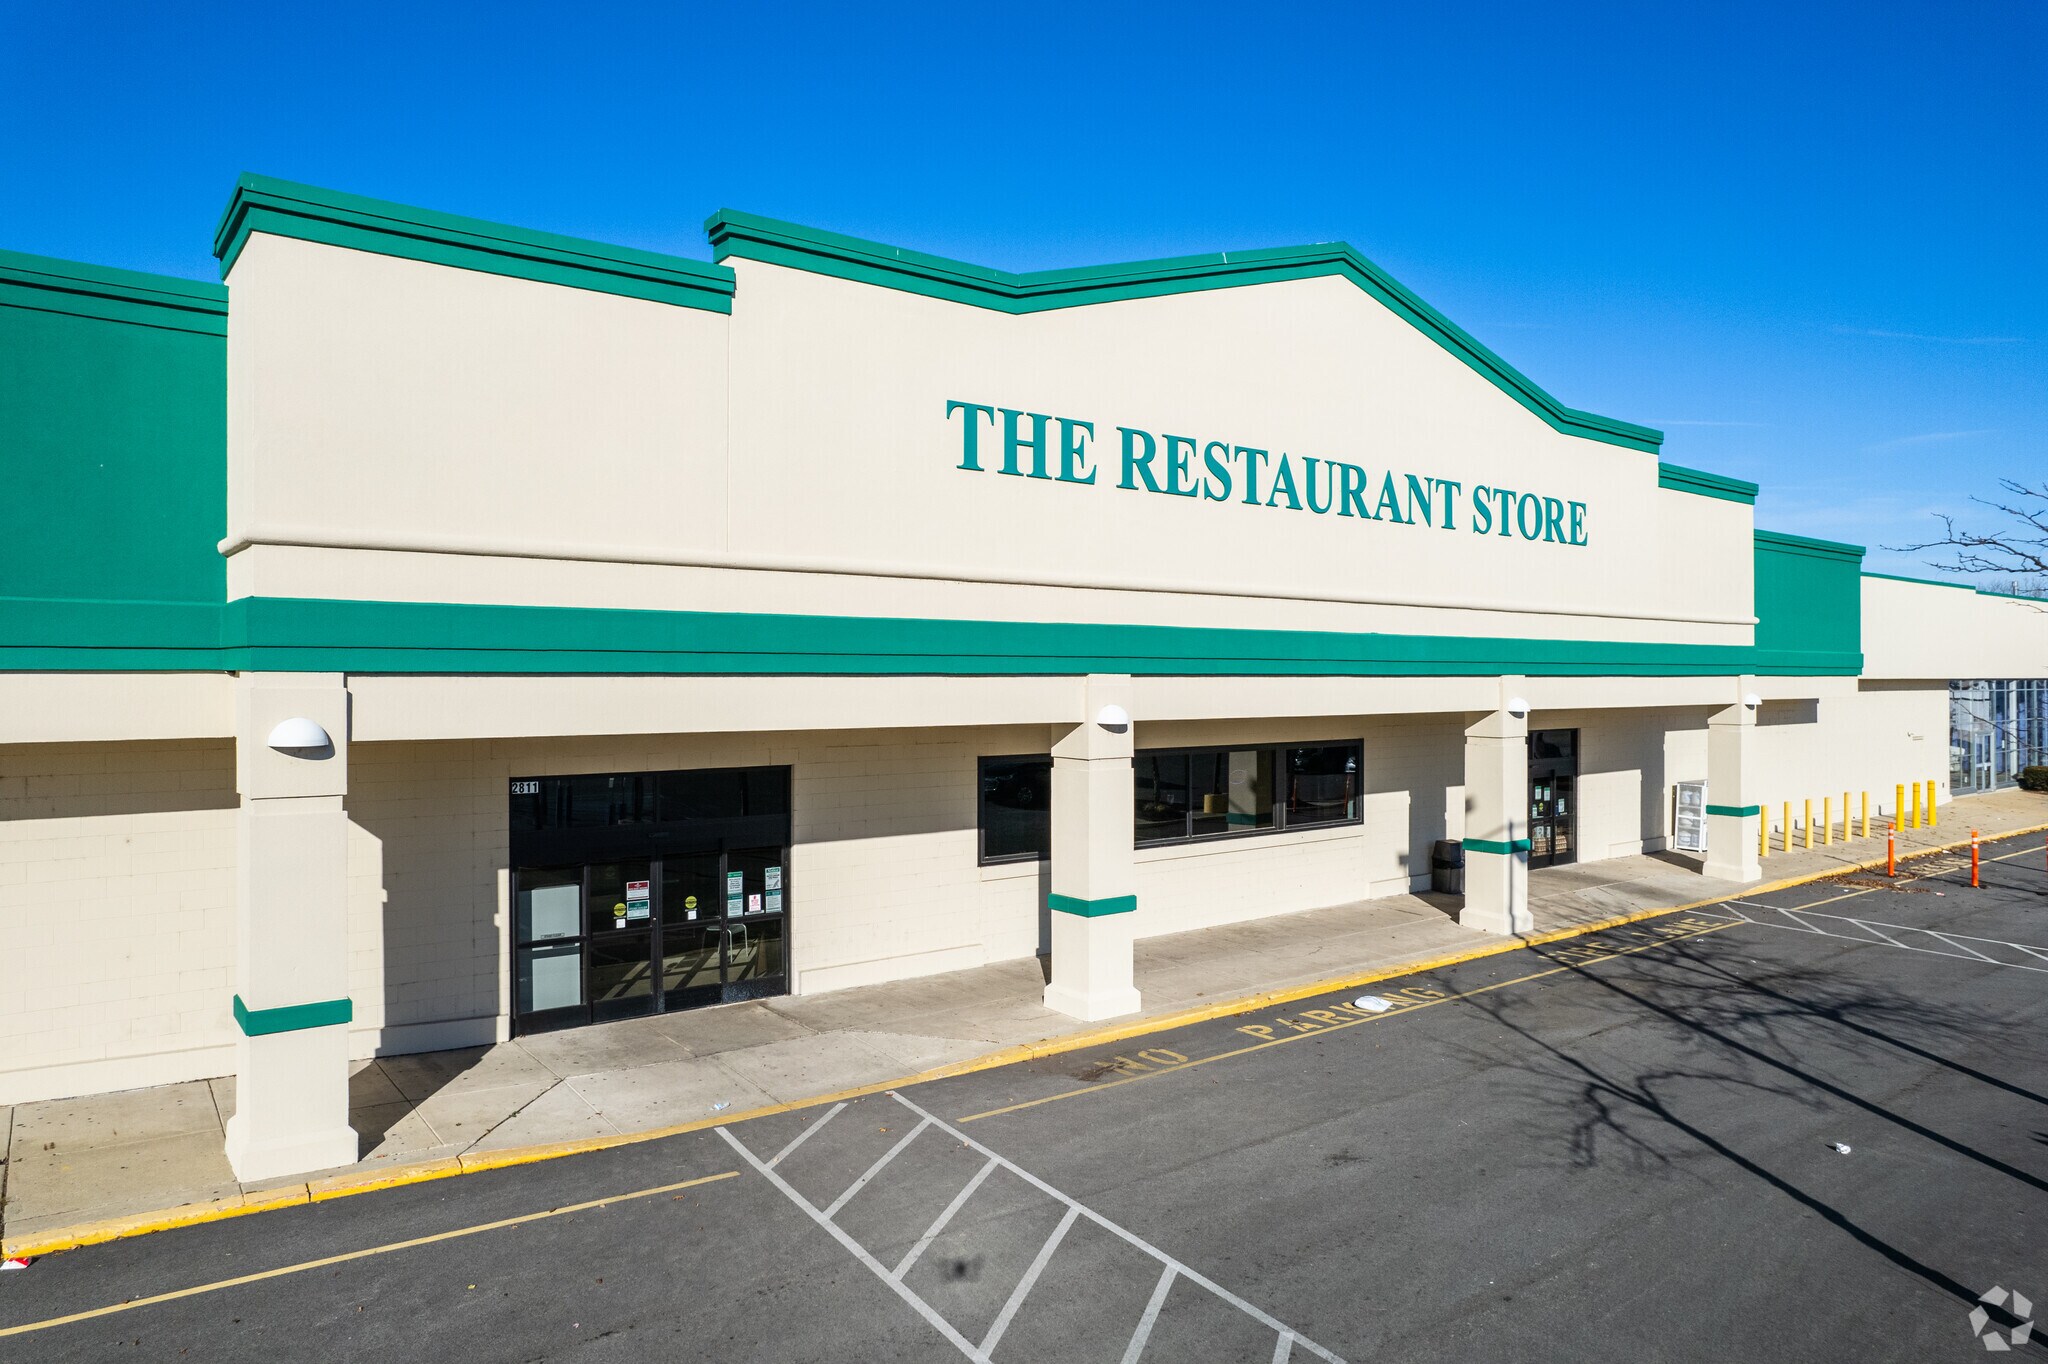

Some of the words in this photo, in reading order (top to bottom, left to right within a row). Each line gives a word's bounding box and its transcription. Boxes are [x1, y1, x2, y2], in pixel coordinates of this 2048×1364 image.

[946, 400, 1097, 485] THE
[1116, 427, 1461, 530] RESTAURANT
[1472, 485, 1588, 547] STORE
[512, 782, 538, 794] 2811
[1093, 1048, 1189, 1077] NO
[1235, 987, 1446, 1040] PARKNG
